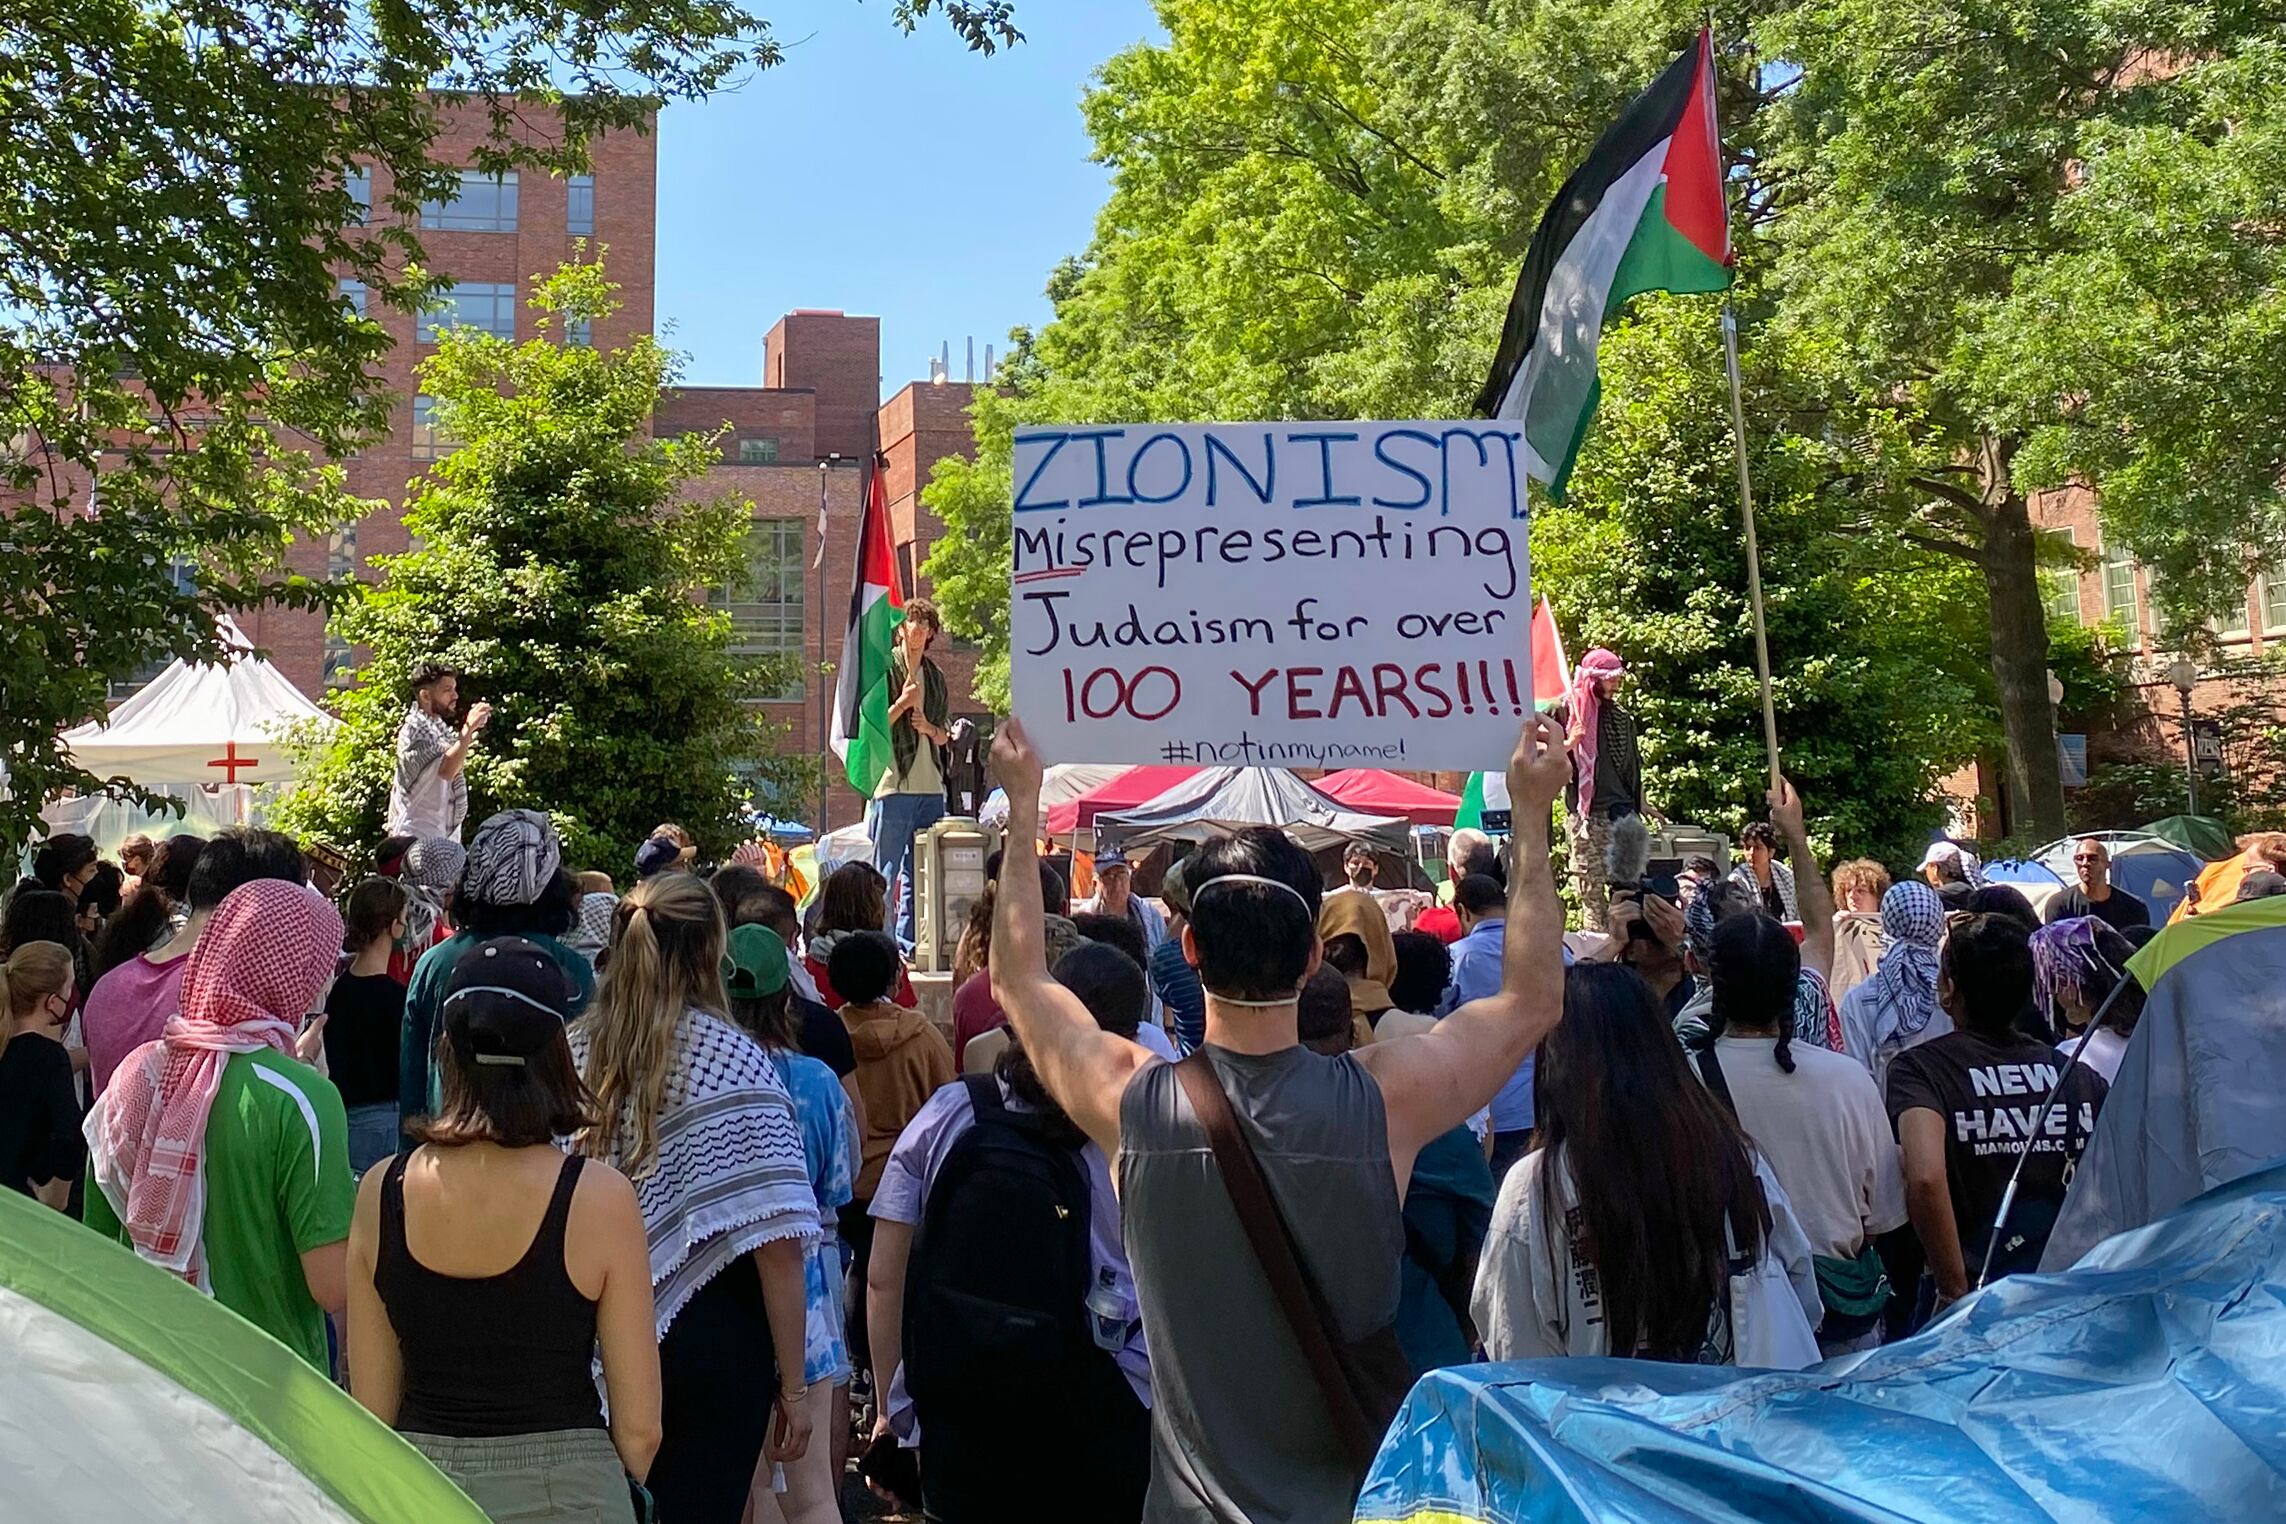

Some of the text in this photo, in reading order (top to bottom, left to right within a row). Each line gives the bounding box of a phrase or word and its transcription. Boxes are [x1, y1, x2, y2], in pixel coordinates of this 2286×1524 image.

[1014, 429, 1528, 519] ZIONISM
[1014, 516, 1516, 599] Misrepresenting
[1023, 592, 1505, 656] Judaism for over
[1063, 658, 1523, 722] 100 YEARS!!!
[1160, 730, 1406, 768] #notinmyname!
[1968, 1062, 2060, 1097] NEW
[1955, 1102, 2094, 1142] HAVEN
[1974, 1138, 2085, 1156] MAMOUNS.CM
